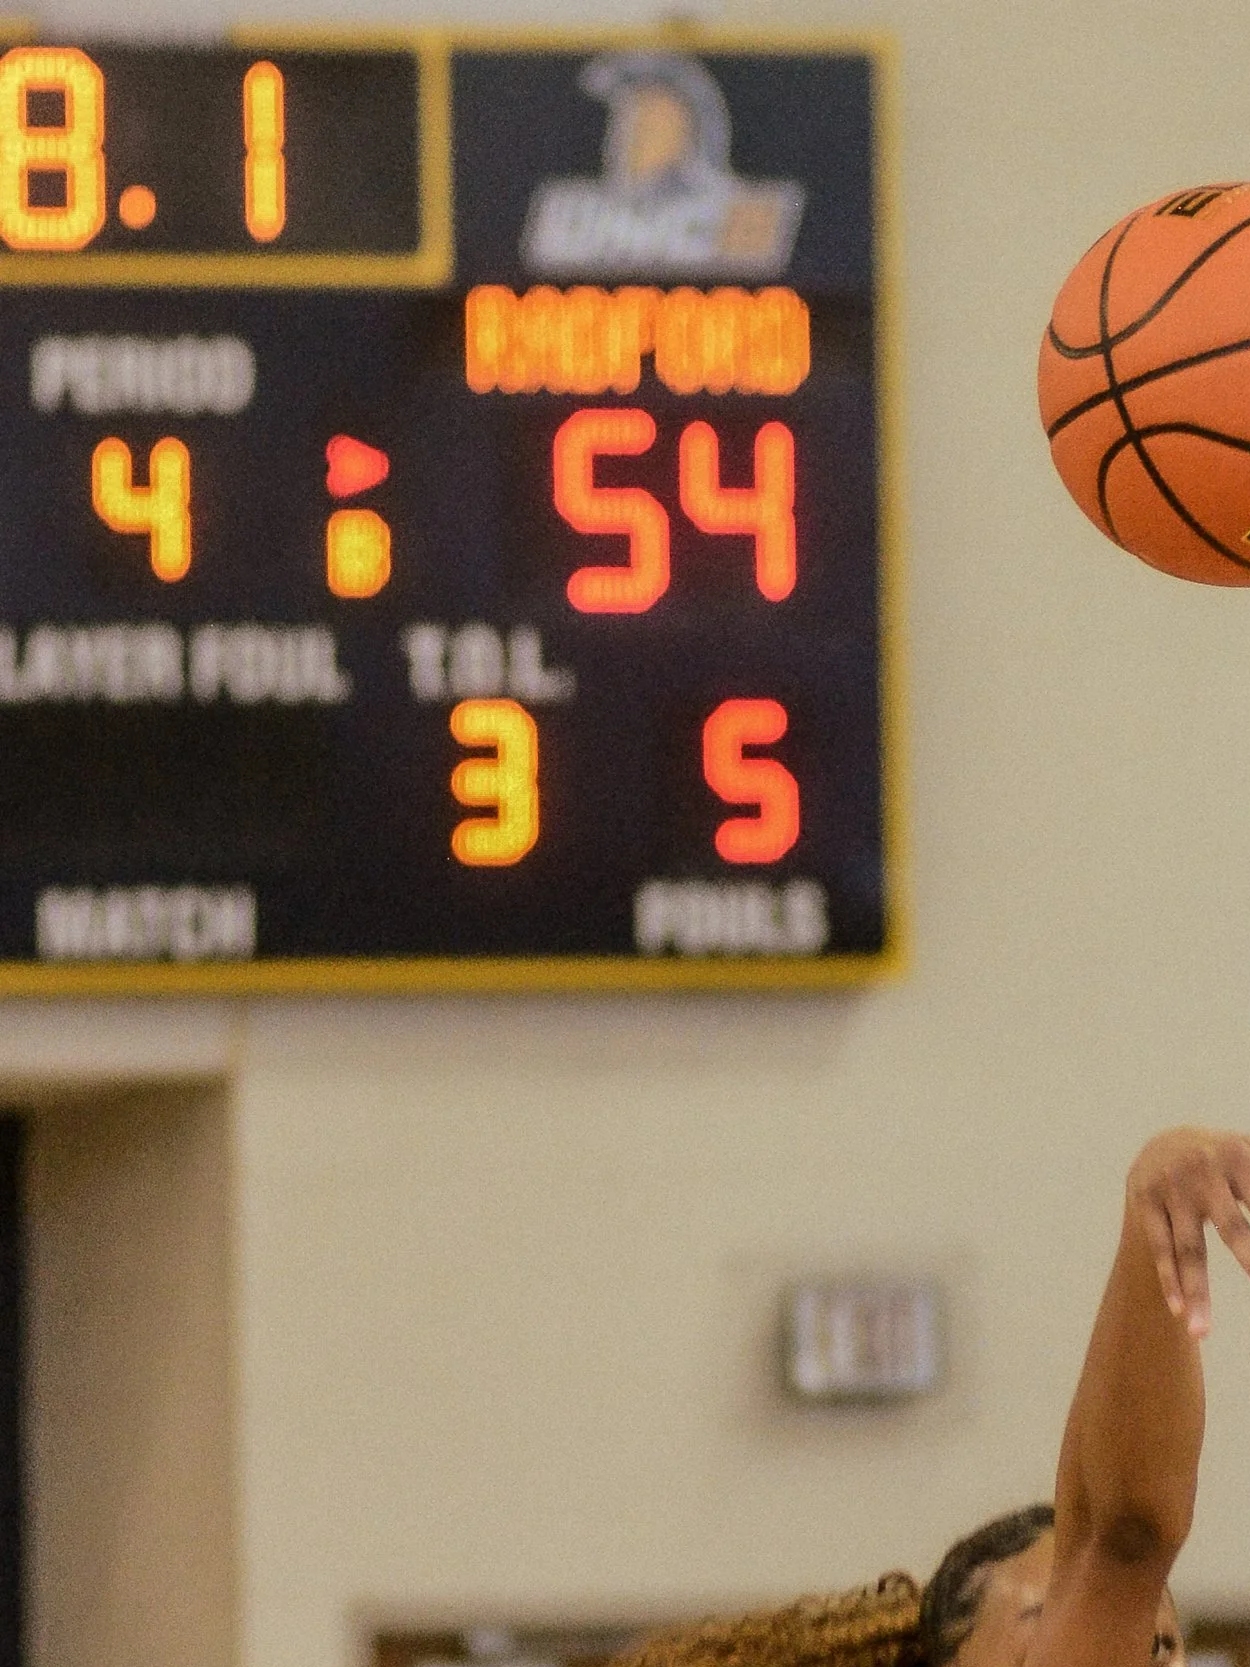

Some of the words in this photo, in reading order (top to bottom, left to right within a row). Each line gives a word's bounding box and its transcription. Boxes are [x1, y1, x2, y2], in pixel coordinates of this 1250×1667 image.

[91, 436, 192, 582] 4
[553, 408, 797, 614] 54
[450, 699, 539, 867] 3
[703, 699, 800, 865] 5
